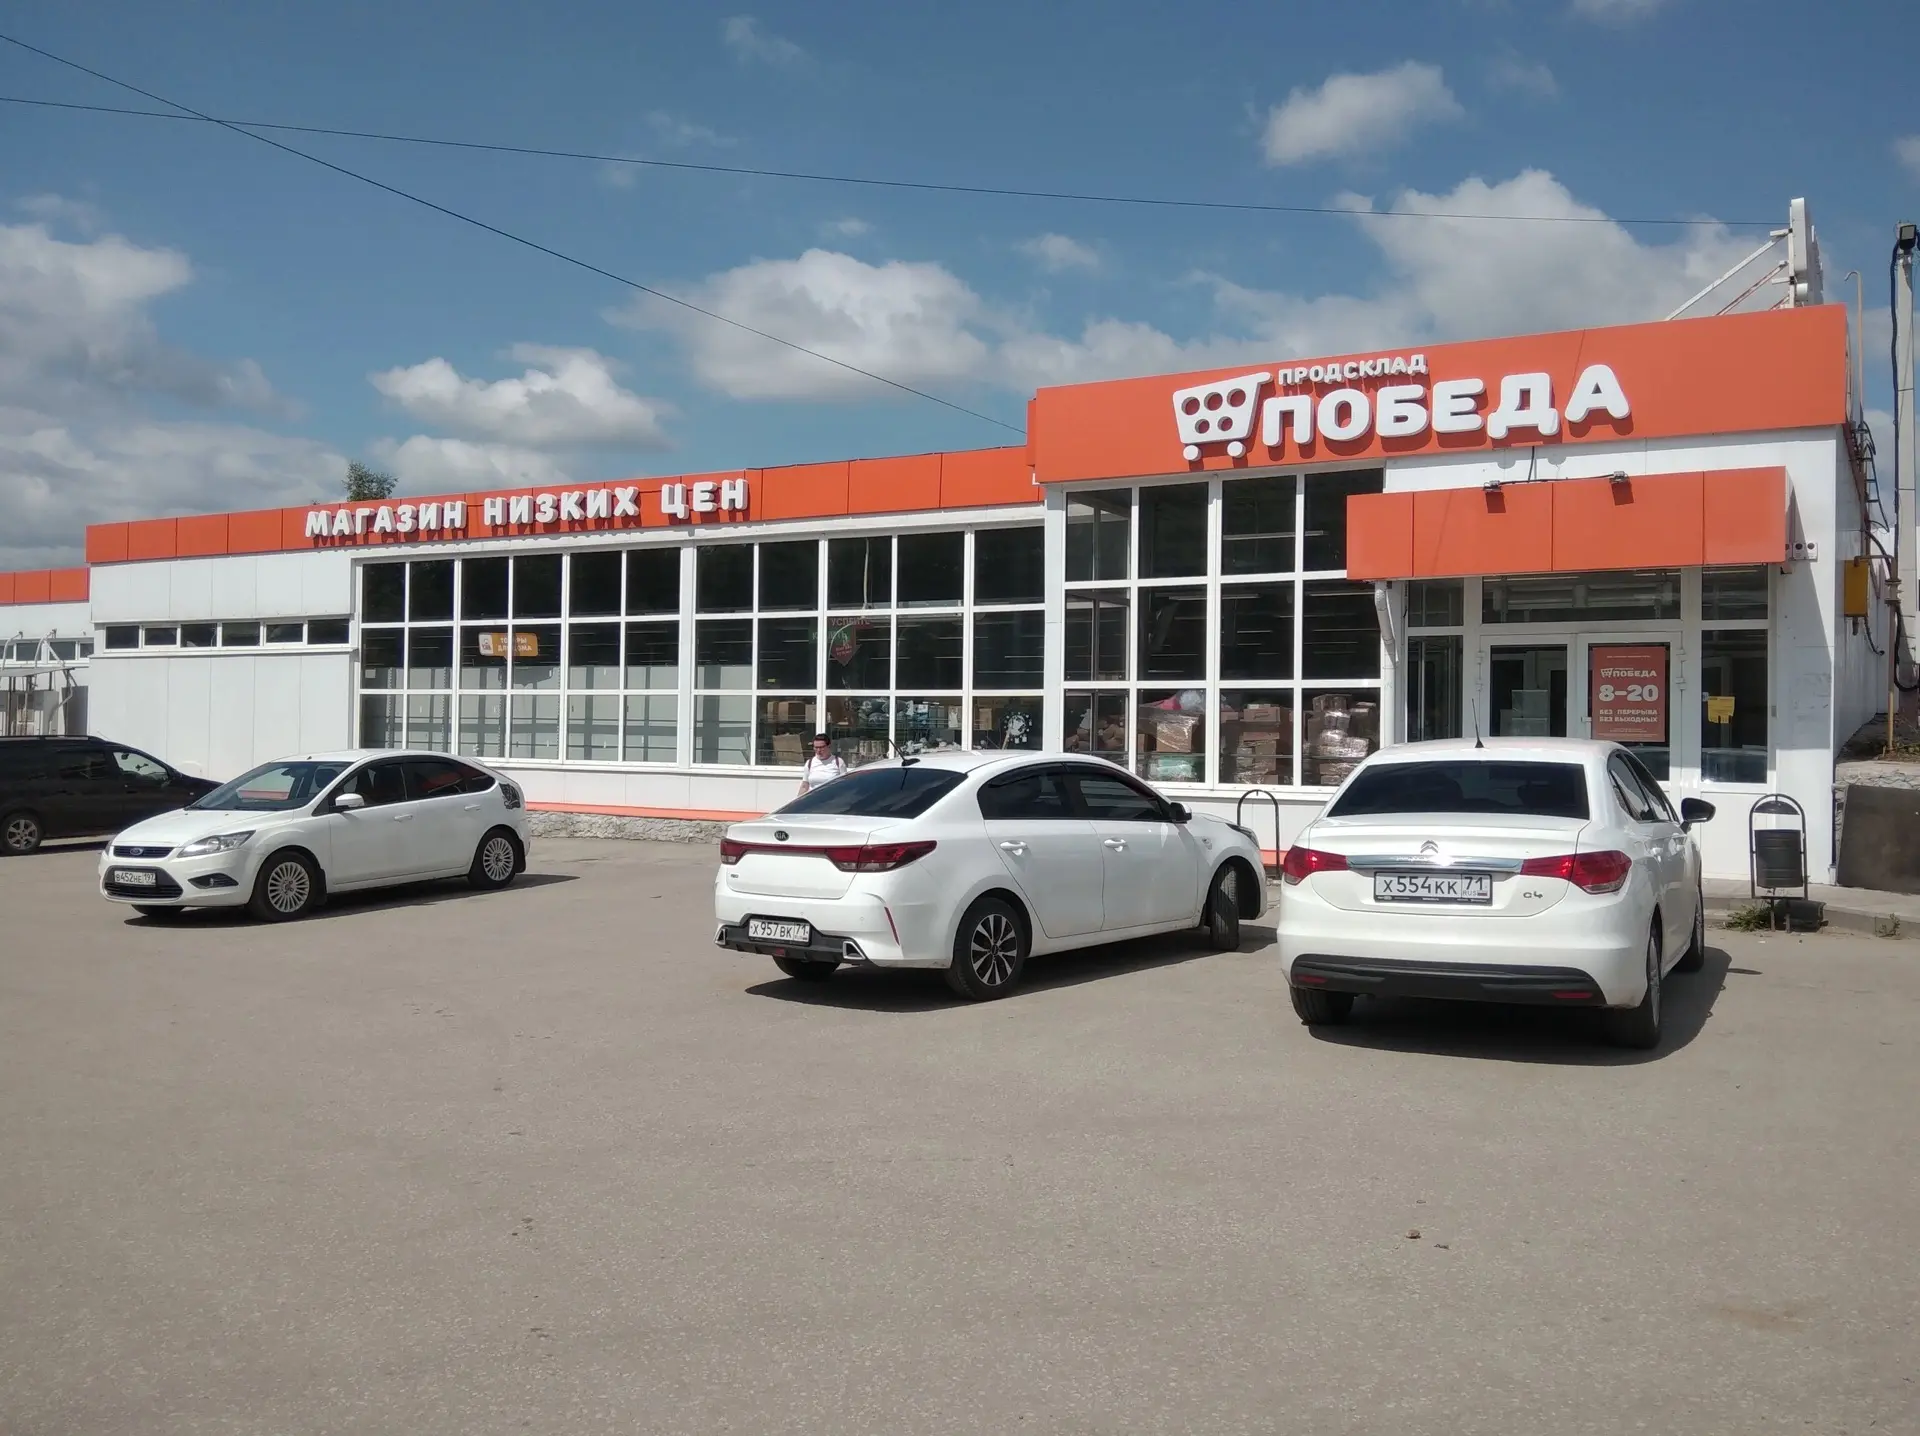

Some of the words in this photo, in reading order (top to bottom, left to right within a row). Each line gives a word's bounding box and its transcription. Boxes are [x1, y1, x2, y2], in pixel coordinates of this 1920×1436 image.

[1278, 354, 1429, 386] ПРОДСКЛАД
[1262, 364, 1631, 448] ПОБЕДА
[305, 500, 467, 538] МАГАЗИН
[484, 486, 640, 526] НИЗКИХ
[661, 478, 749, 520] ЦЕН
[1612, 670, 1657, 678] ПОБЕДА
[1598, 684, 1659, 702] 8-20
[1464, 877, 1483, 891] 71
[1523, 891, 1543, 900] C4
